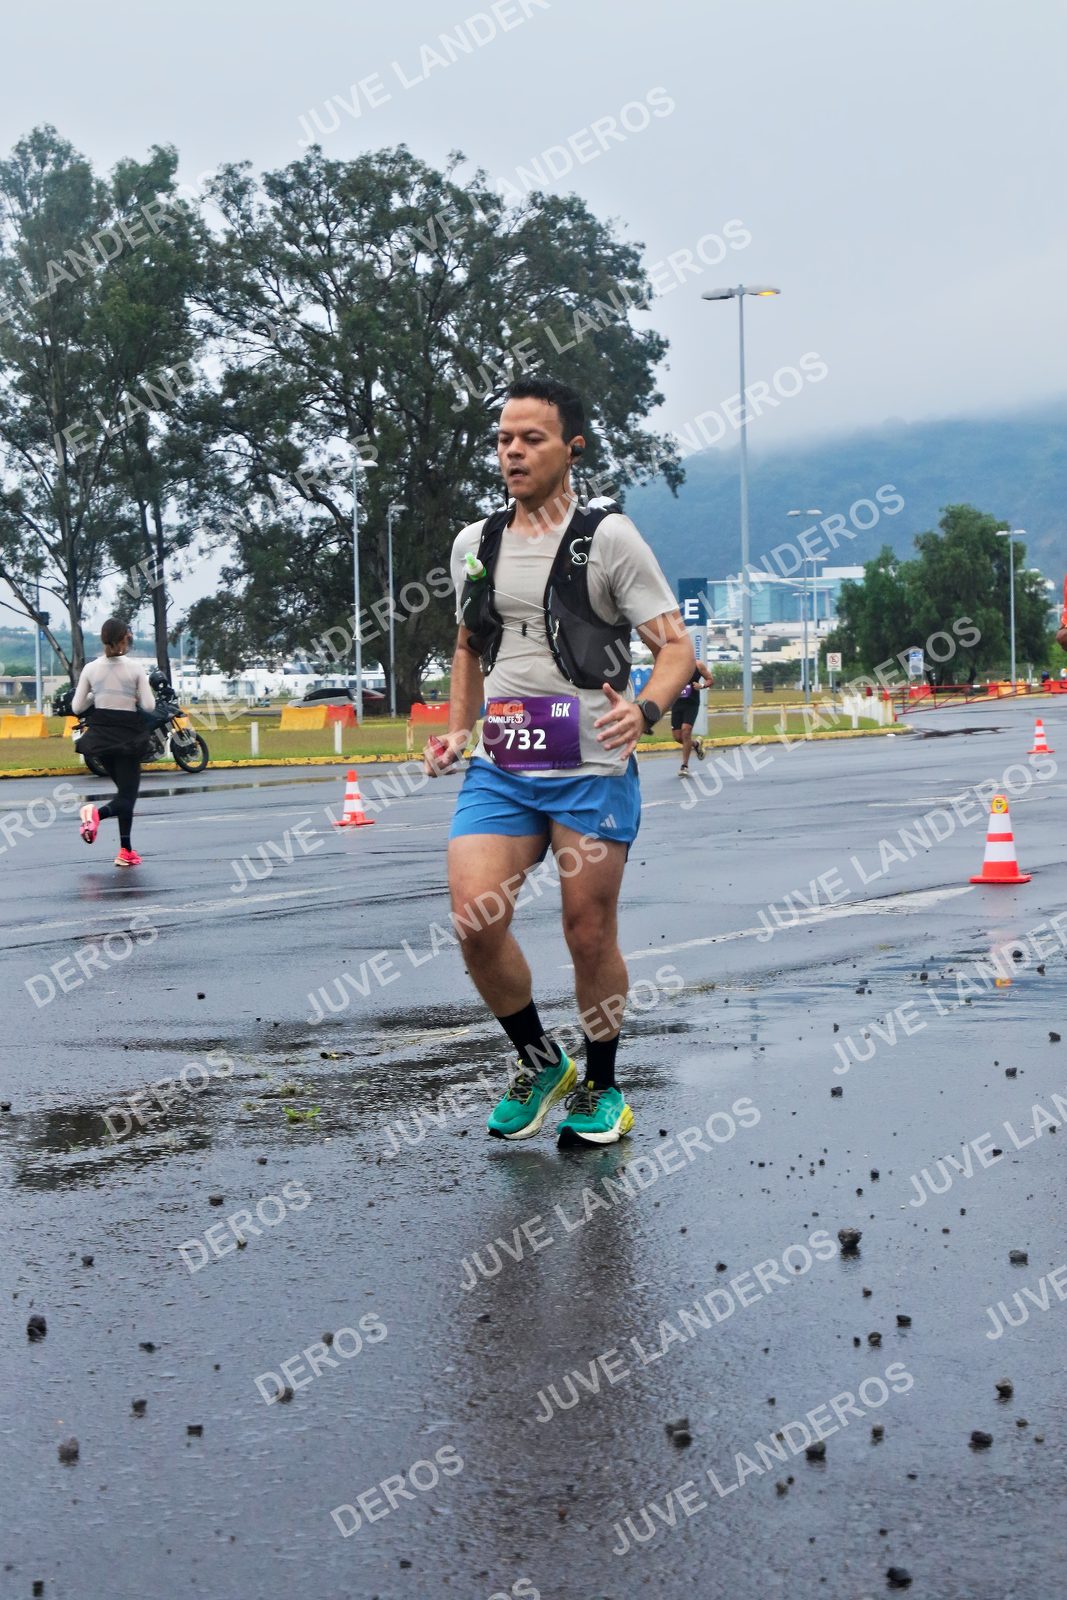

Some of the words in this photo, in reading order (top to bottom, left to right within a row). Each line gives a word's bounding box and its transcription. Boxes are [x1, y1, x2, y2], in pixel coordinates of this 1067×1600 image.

[684, 598, 700, 619] E
[551, 702, 571, 717] 15K
[504, 728, 547, 750] 732
